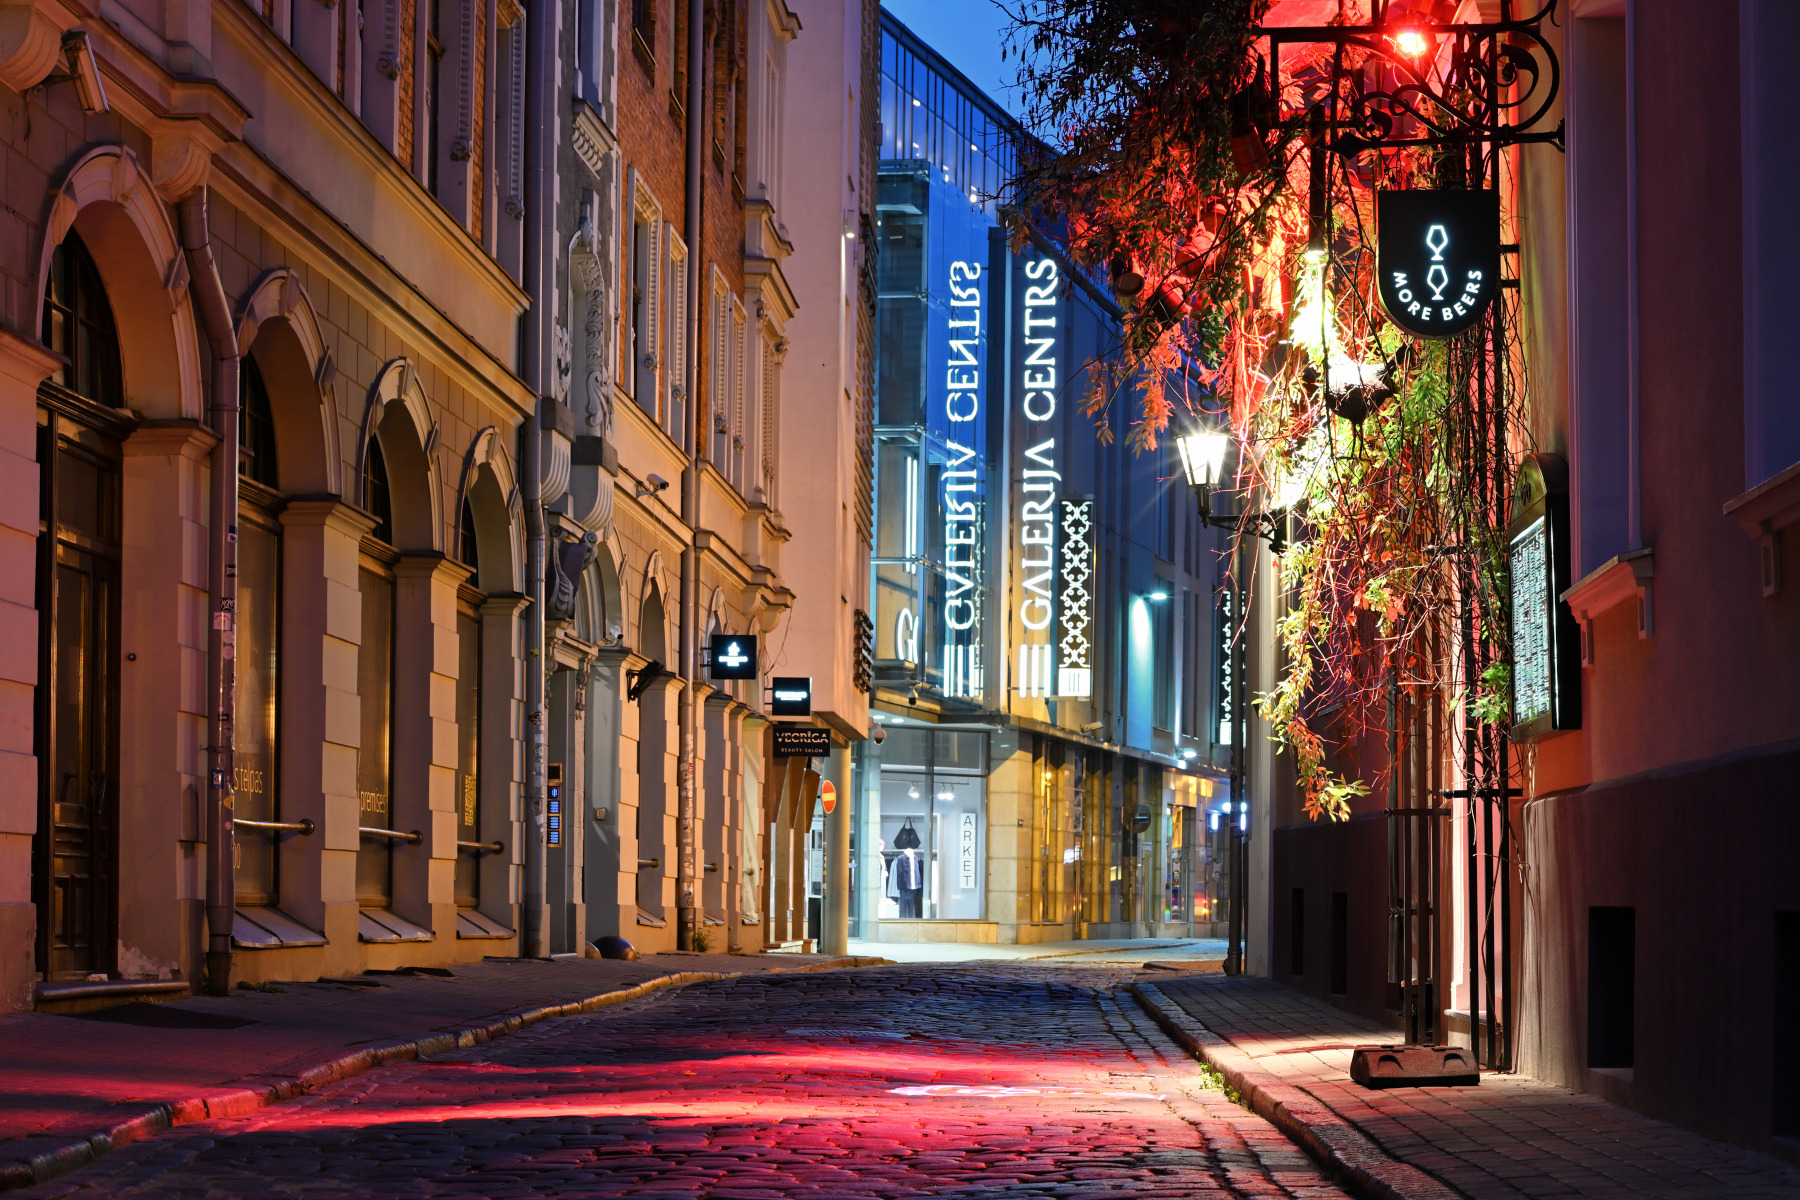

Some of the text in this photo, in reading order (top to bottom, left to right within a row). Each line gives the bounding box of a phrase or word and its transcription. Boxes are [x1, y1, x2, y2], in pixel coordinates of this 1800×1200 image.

[1393, 270, 1482, 321] MORE BEERS
[1020, 259, 1061, 631] GALERIJA CENTRS
[240, 761, 264, 801] telpas
[360, 787, 386, 818] premises
[962, 815, 973, 887] ARKET
